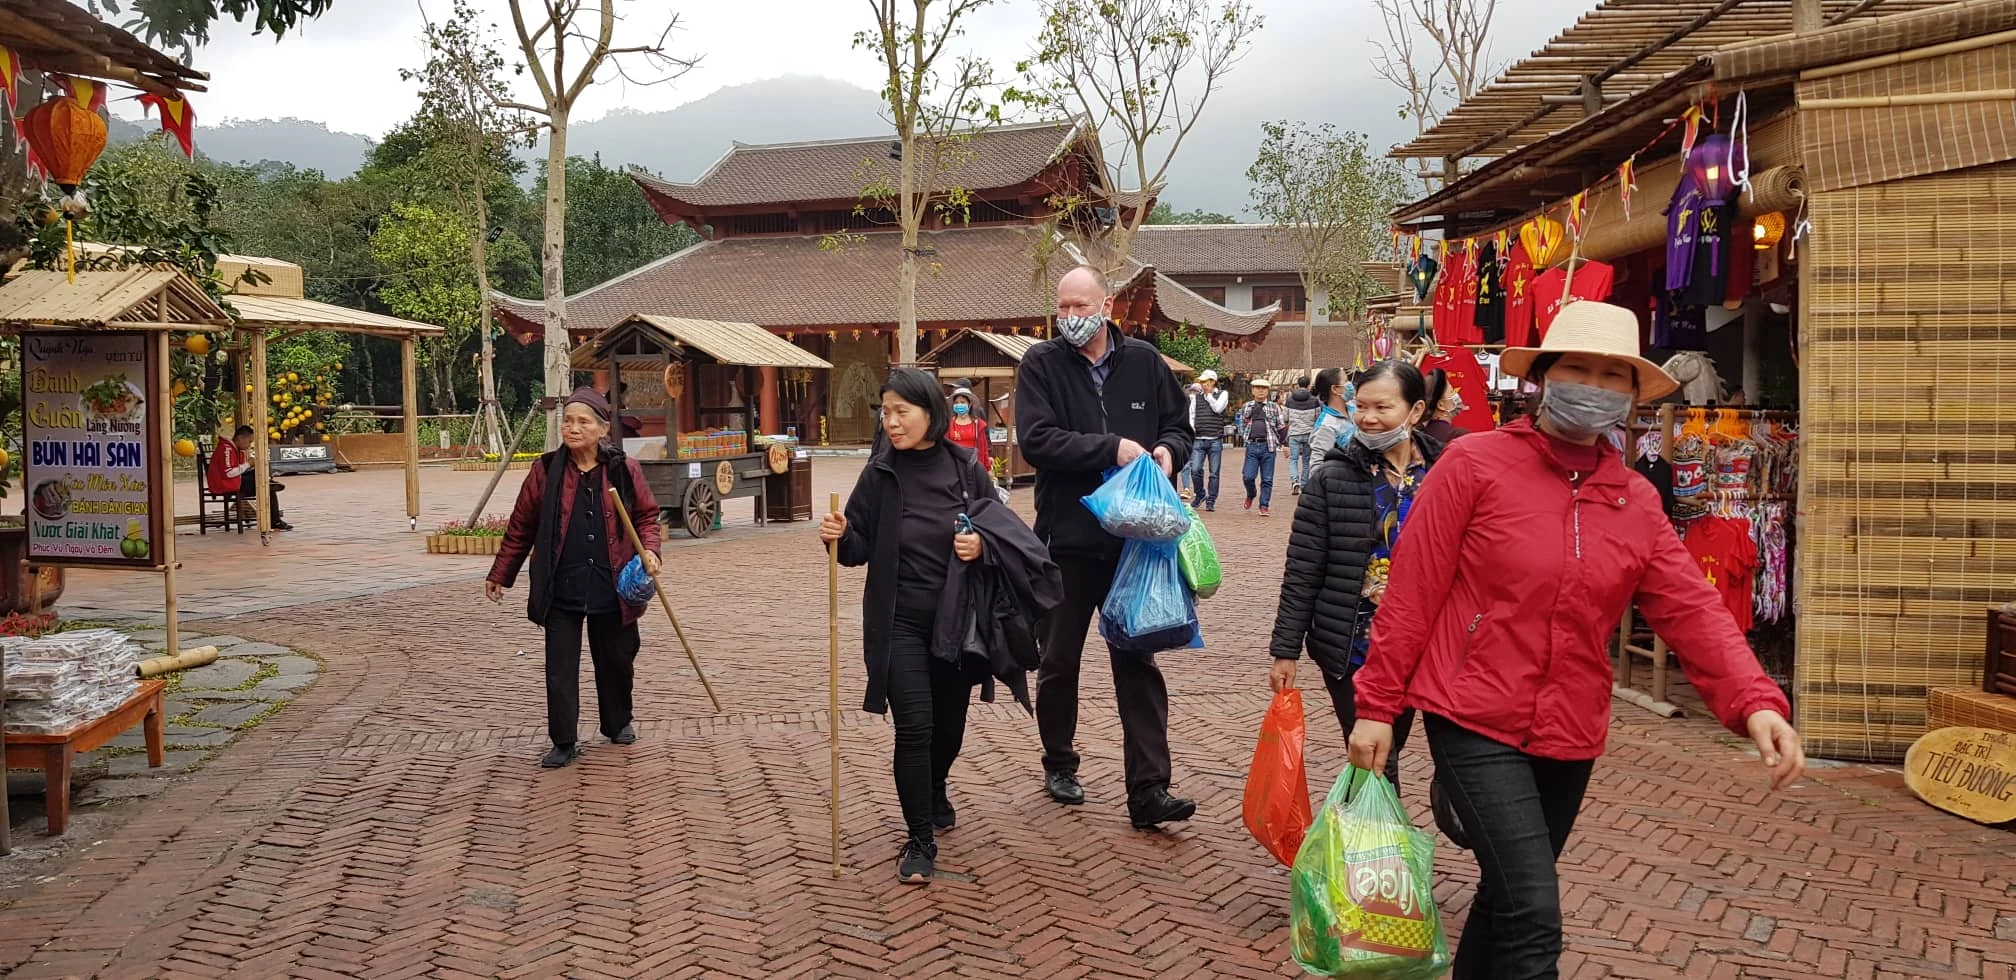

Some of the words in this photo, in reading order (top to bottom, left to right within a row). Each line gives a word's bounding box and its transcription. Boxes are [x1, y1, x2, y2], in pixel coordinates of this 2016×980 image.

[32, 436, 67, 466] BÚN
[72, 434, 101, 467] HẢI
[106, 435, 141, 467] SẢN
[71, 497, 99, 514] BÁNH
[101, 497, 122, 514] DÂN
[124, 501, 148, 515] GIAN
[1974, 744, 1993, 762] TRỊ
